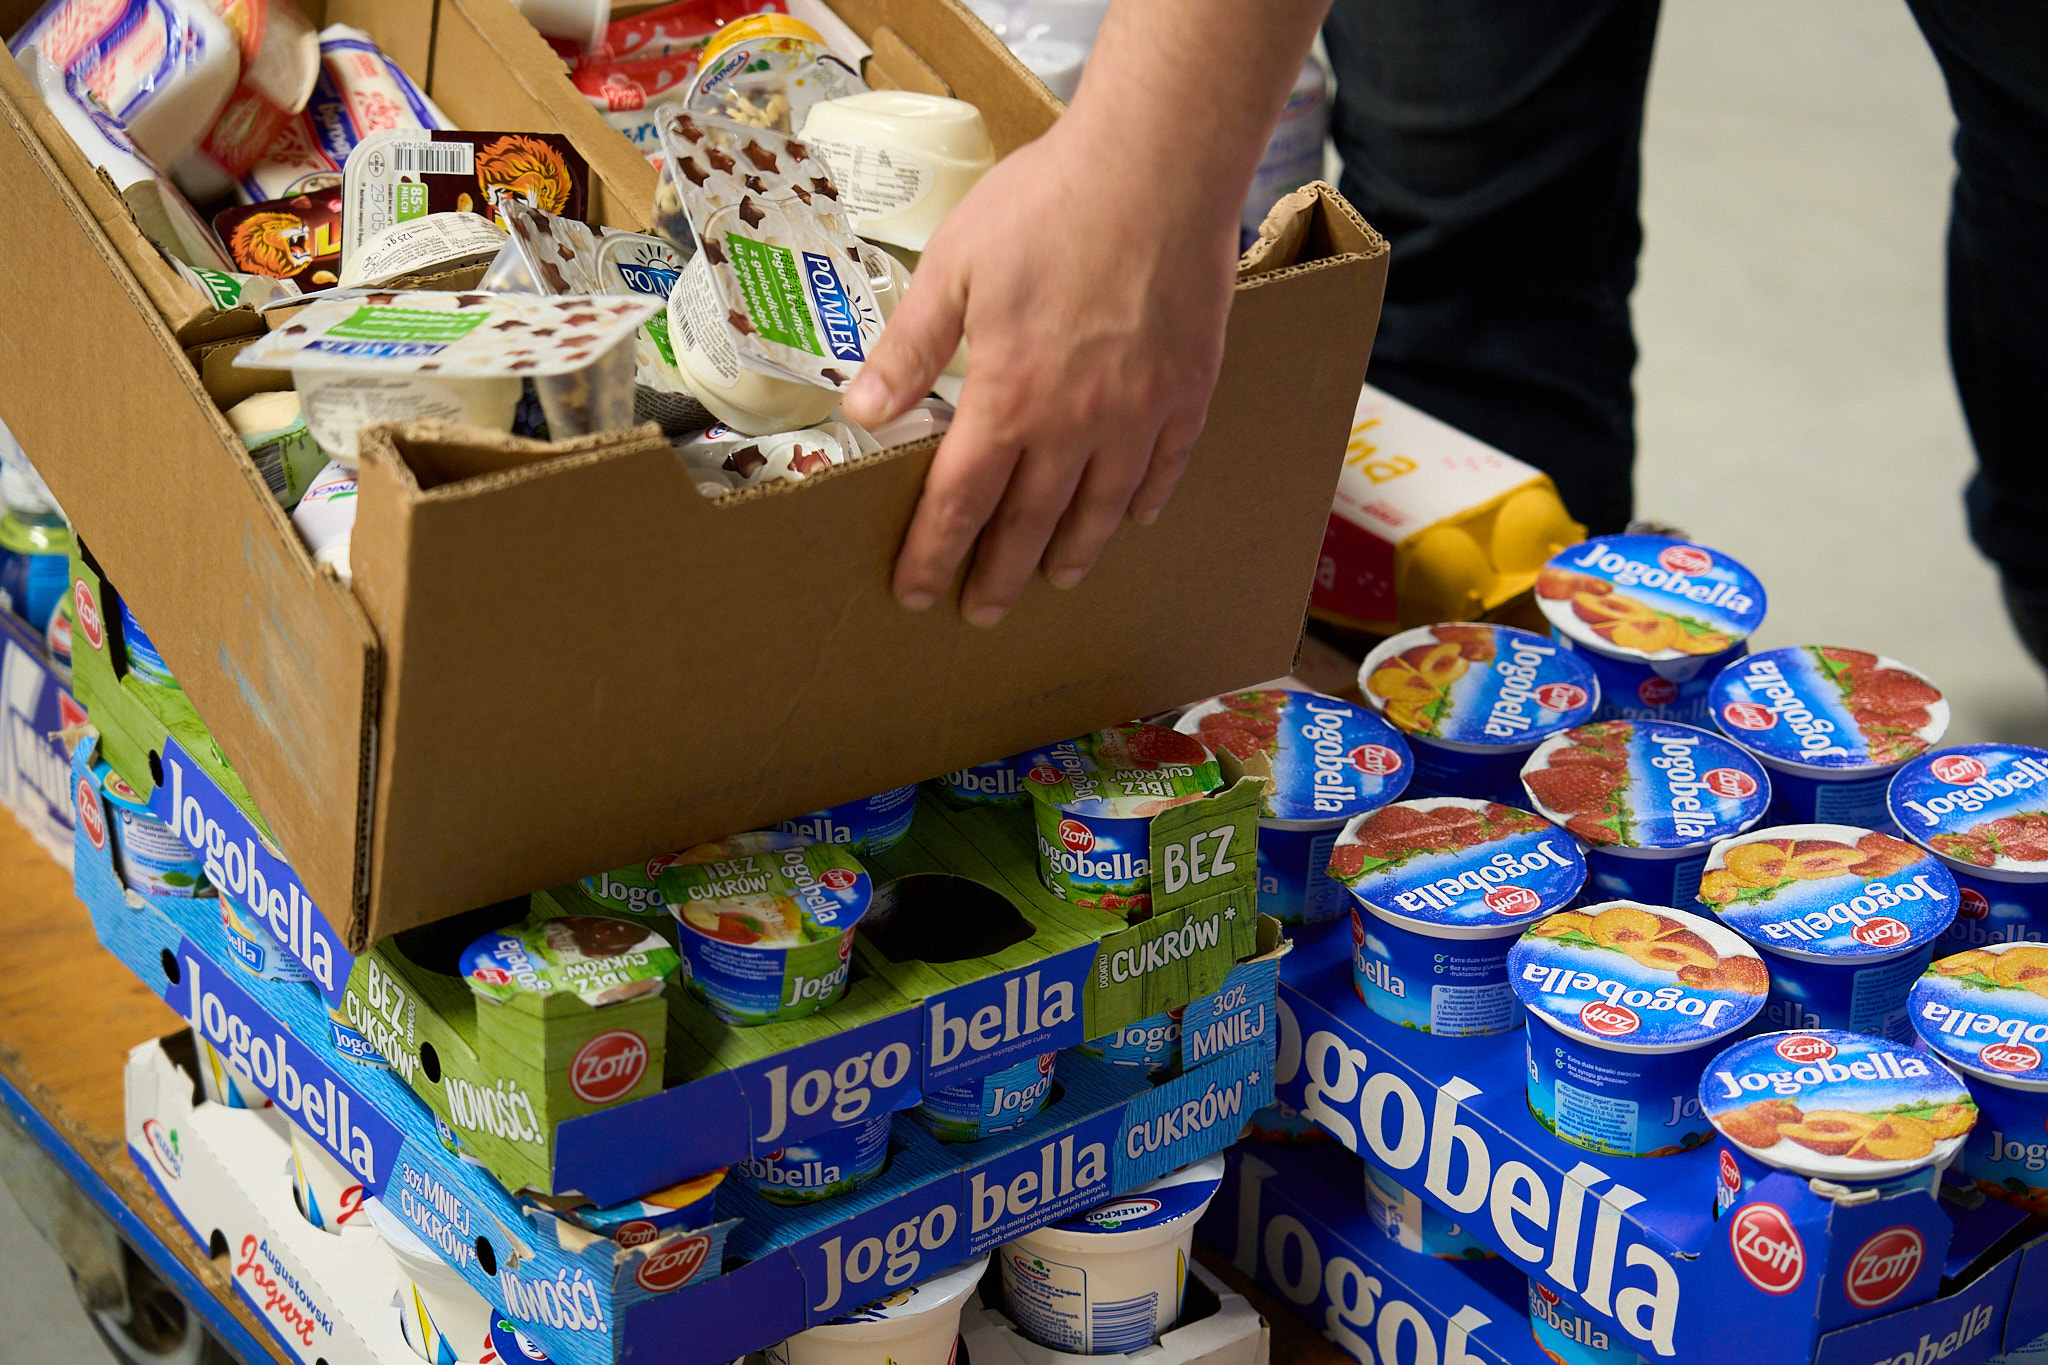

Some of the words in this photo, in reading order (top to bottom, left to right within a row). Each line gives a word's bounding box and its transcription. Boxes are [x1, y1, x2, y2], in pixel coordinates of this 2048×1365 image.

[401, 186, 409, 214] MILCH
[410, 186, 423, 214] 85%
[621, 268, 677, 299] POLM
[738, 258, 770, 330] czekoladzie
[750, 259, 788, 334] gwiazdkami
[768, 246, 791, 292] jogurt
[785, 293, 814, 354] kremowy
[807, 256, 860, 358] POLMLEK
[1574, 542, 1754, 616] Jogobella
[1665, 549, 1709, 574] Zott
[78, 592, 101, 634] Zott
[1484, 638, 1556, 738] Jogobella
[1550, 684, 1573, 713] Zott
[1749, 660, 1848, 759] Jogobella
[1734, 702, 1768, 730] Zott
[1050, 742, 1104, 805] Jogobella
[1301, 702, 1356, 814] Jogobella
[1364, 743, 1388, 775] Zott
[1937, 760, 1977, 781] Zott
[1122, 781, 1164, 796] BEZ
[1650, 732, 1707, 839] Jogobella
[1714, 768, 1741, 798] Zott
[1902, 757, 2048, 826] Jogobell
[80, 789, 102, 837] Zott
[1062, 826, 1093, 848] Zott
[164, 759, 334, 992] Jogobella
[714, 855, 762, 880] BEZ
[1164, 824, 1236, 894] BEZ
[1398, 839, 1574, 914] Jogobella
[774, 846, 842, 925] Jogobella
[1488, 886, 1536, 918] Zott
[1760, 874, 1949, 941] Jogobella
[226, 930, 257, 964] bella
[1860, 920, 1906, 943] Zott
[1099, 953, 1109, 988] DODATKU
[368, 958, 406, 1034] BEZ
[1213, 983, 1248, 1016] 30%
[1522, 963, 1734, 1028] Jogobella
[1587, 1005, 1636, 1031] Zott
[406, 998, 416, 1048] DODATKU
[928, 971, 1076, 1069] bella
[1192, 1004, 1265, 1062] MNIEJ
[1922, 1000, 2048, 1048] obella
[184, 956, 376, 1184] Jogobella
[580, 1045, 647, 1087] Zott
[934, 1064, 959, 1078] zawiera
[960, 1053, 992, 1068] naturalnie
[992, 1040, 1032, 1057] występujące
[1032, 1032, 1052, 1043] cukry
[1567, 1055, 1581, 1066] Extra
[1581, 1060, 1595, 1070] duże
[1594, 1064, 1616, 1075] kawałki
[1567, 1063, 1577, 1072] Bez
[1578, 1068, 1596, 1079] syropu
[1783, 1040, 1831, 1059] Zott
[1984, 1044, 2036, 1070] Zott
[756, 1042, 913, 1144] Jogo
[1716, 1052, 1930, 1100] Jogobella
[444, 1076, 544, 1146] NOWOŚĆ!
[969, 1136, 1108, 1236] bella
[1720, 1160, 1742, 1185] Zott
[402, 1162, 423, 1196] 30%
[424, 1172, 470, 1236] MNIEJ
[970, 1236, 1002, 1256] jogurtach
[1003, 1220, 1042, 1240] owocowych
[1042, 1204, 1080, 1228] dostępnych
[1080, 1199, 1090, 1208] na
[1090, 1190, 1110, 1204] rynku
[975, 1232, 990, 1242] min.
[991, 1224, 1006, 1236] 30%
[1006, 1216, 1026, 1230] mniej
[1026, 1206, 1050, 1222] cukrów
[1051, 1200, 1062, 1212] niż
[1069, 1182, 1106, 1206] podobnych
[1086, 1205, 1148, 1221] MLEKPOL
[620, 1228, 659, 1246] Zott
[644, 1237, 706, 1276] Zott
[812, 1204, 956, 1314] Jogo
[1738, 1220, 1801, 1274] Zott
[236, 1233, 316, 1346] Jogurt
[259, 1238, 334, 1337] Augustowski
[1018, 1259, 1050, 1280] MLEKPOL
[1854, 1243, 1920, 1288] Zott
[500, 1268, 608, 1334] NOWOŚĆ!
